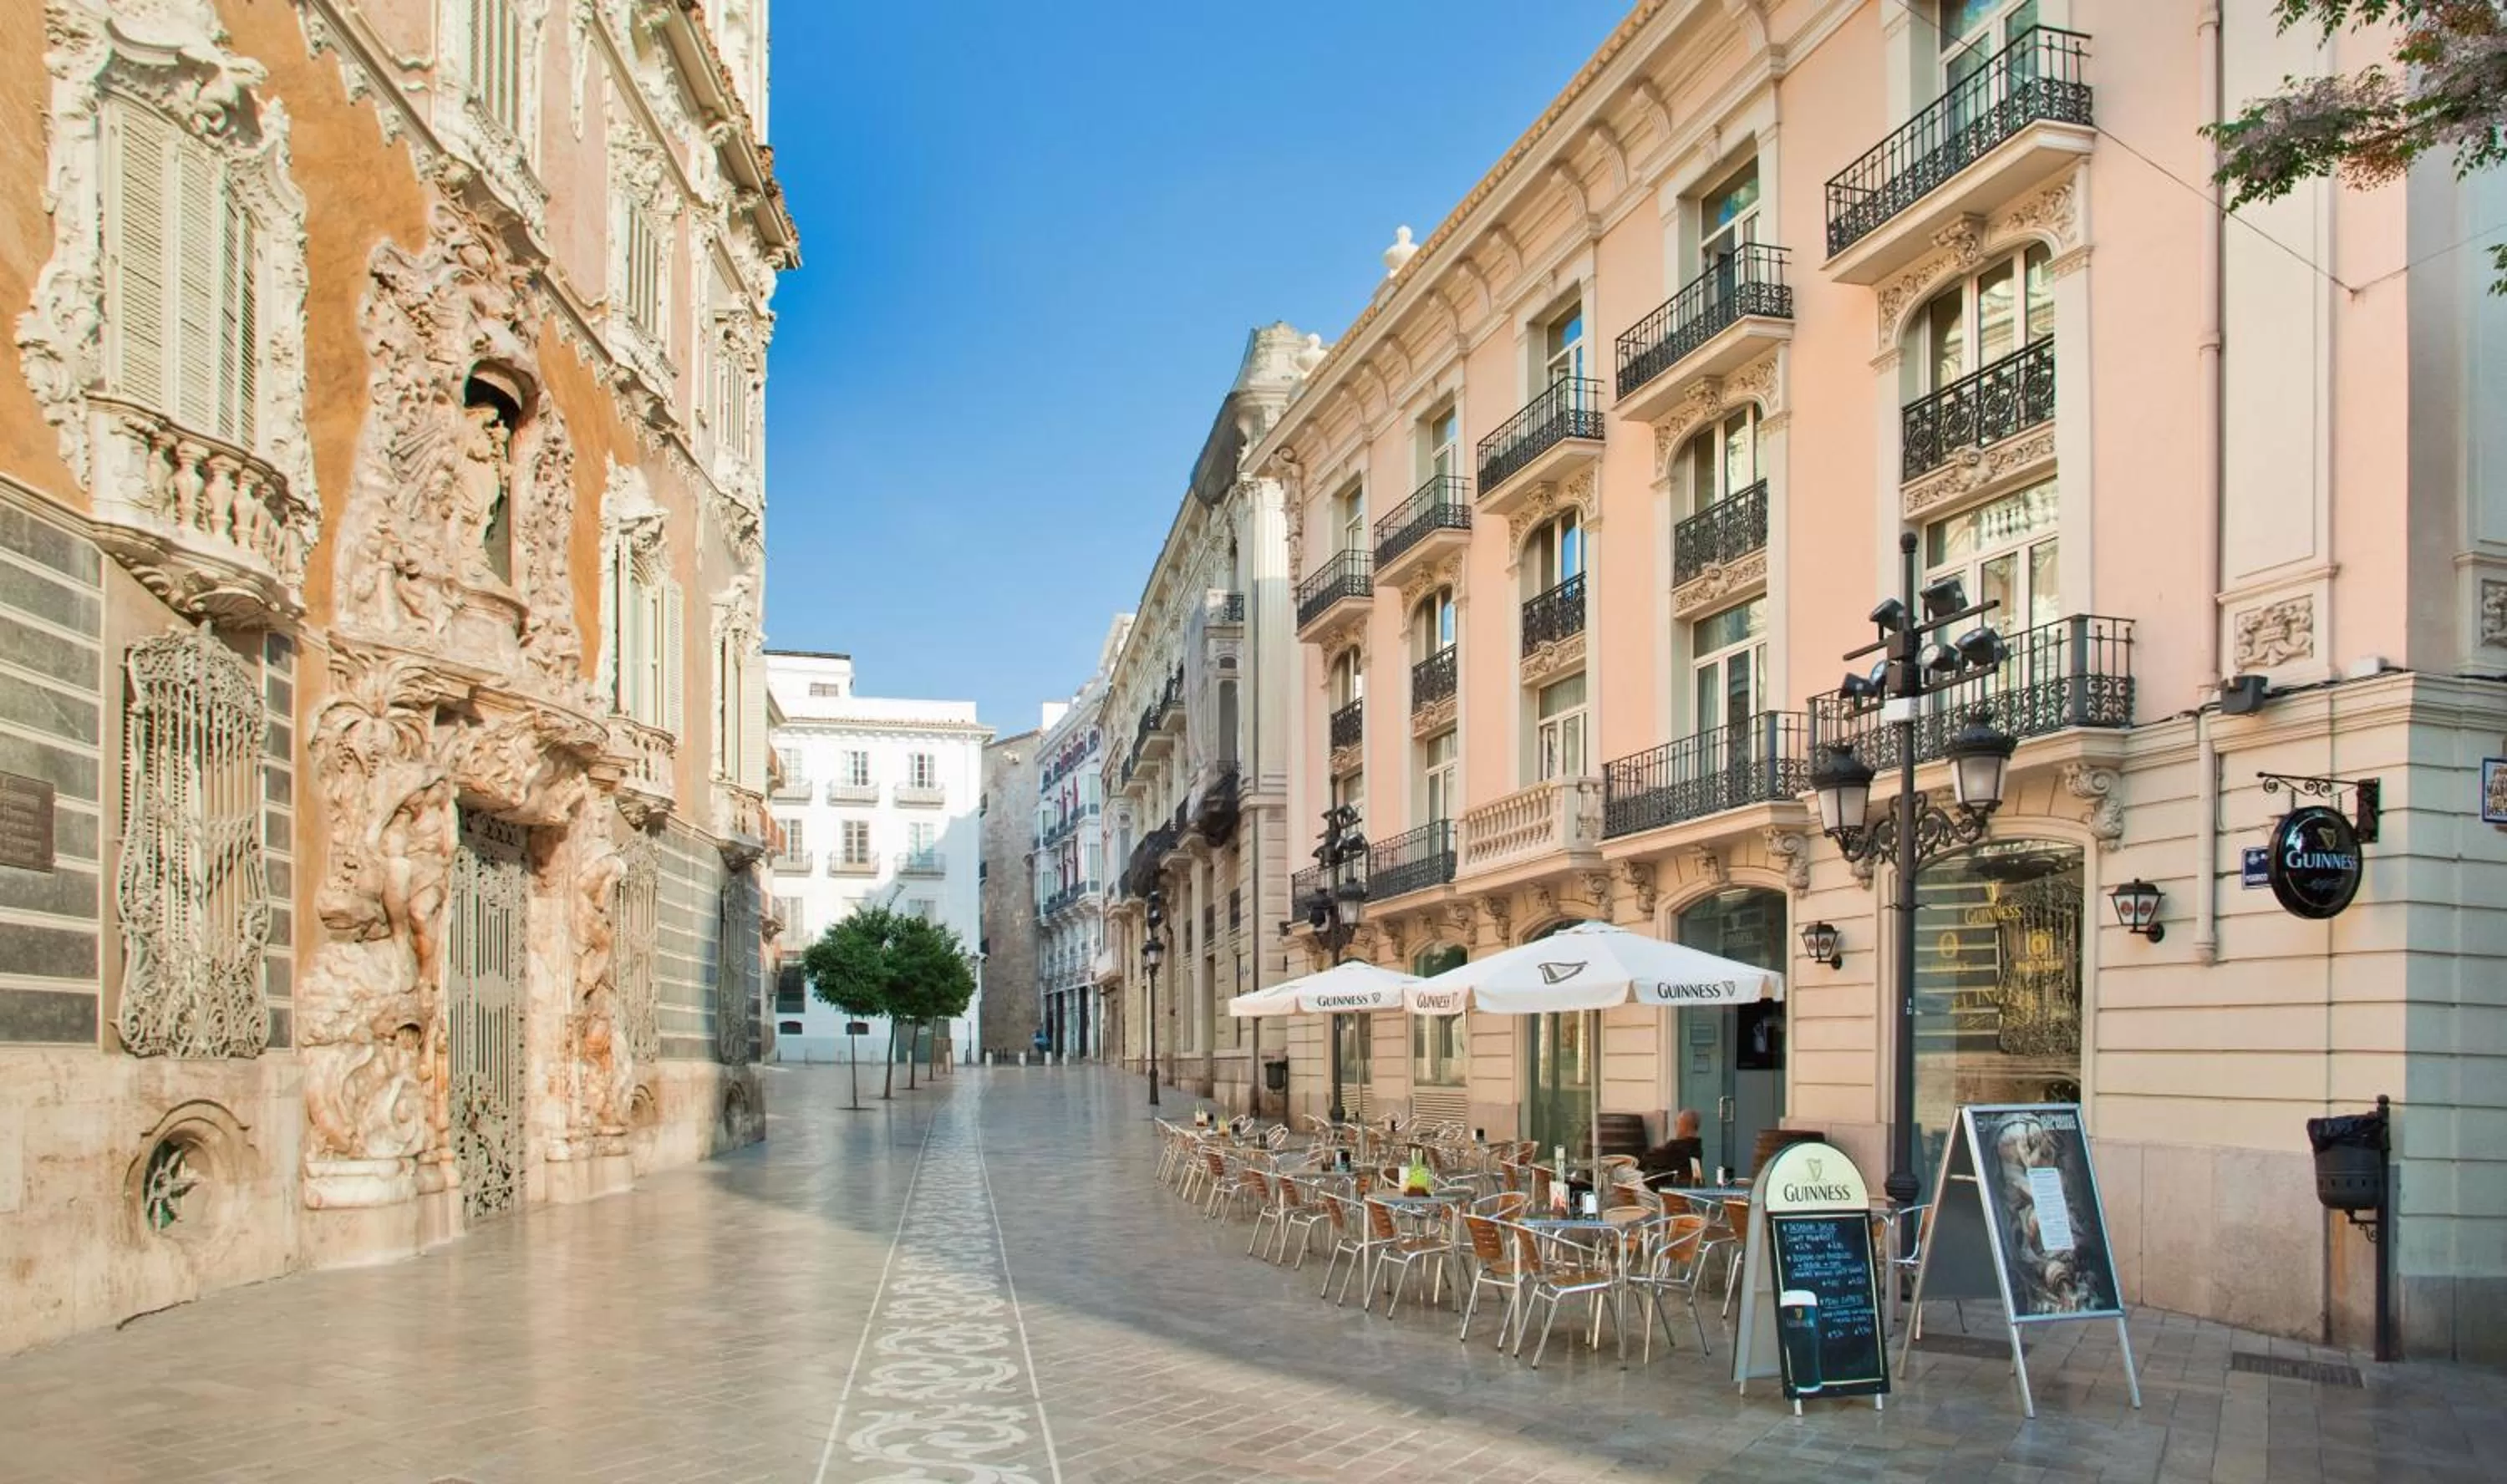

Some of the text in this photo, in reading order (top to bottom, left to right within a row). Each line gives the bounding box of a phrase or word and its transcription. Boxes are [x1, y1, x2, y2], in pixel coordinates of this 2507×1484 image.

[2286, 850, 2357, 871] GUINNESS
[1965, 905, 2021, 924] GUINNESS
[1657, 982, 1721, 999] GUINNESS
[1317, 994, 1368, 1007] GUINNESS
[1783, 1182, 1851, 1202] GUINNESS
